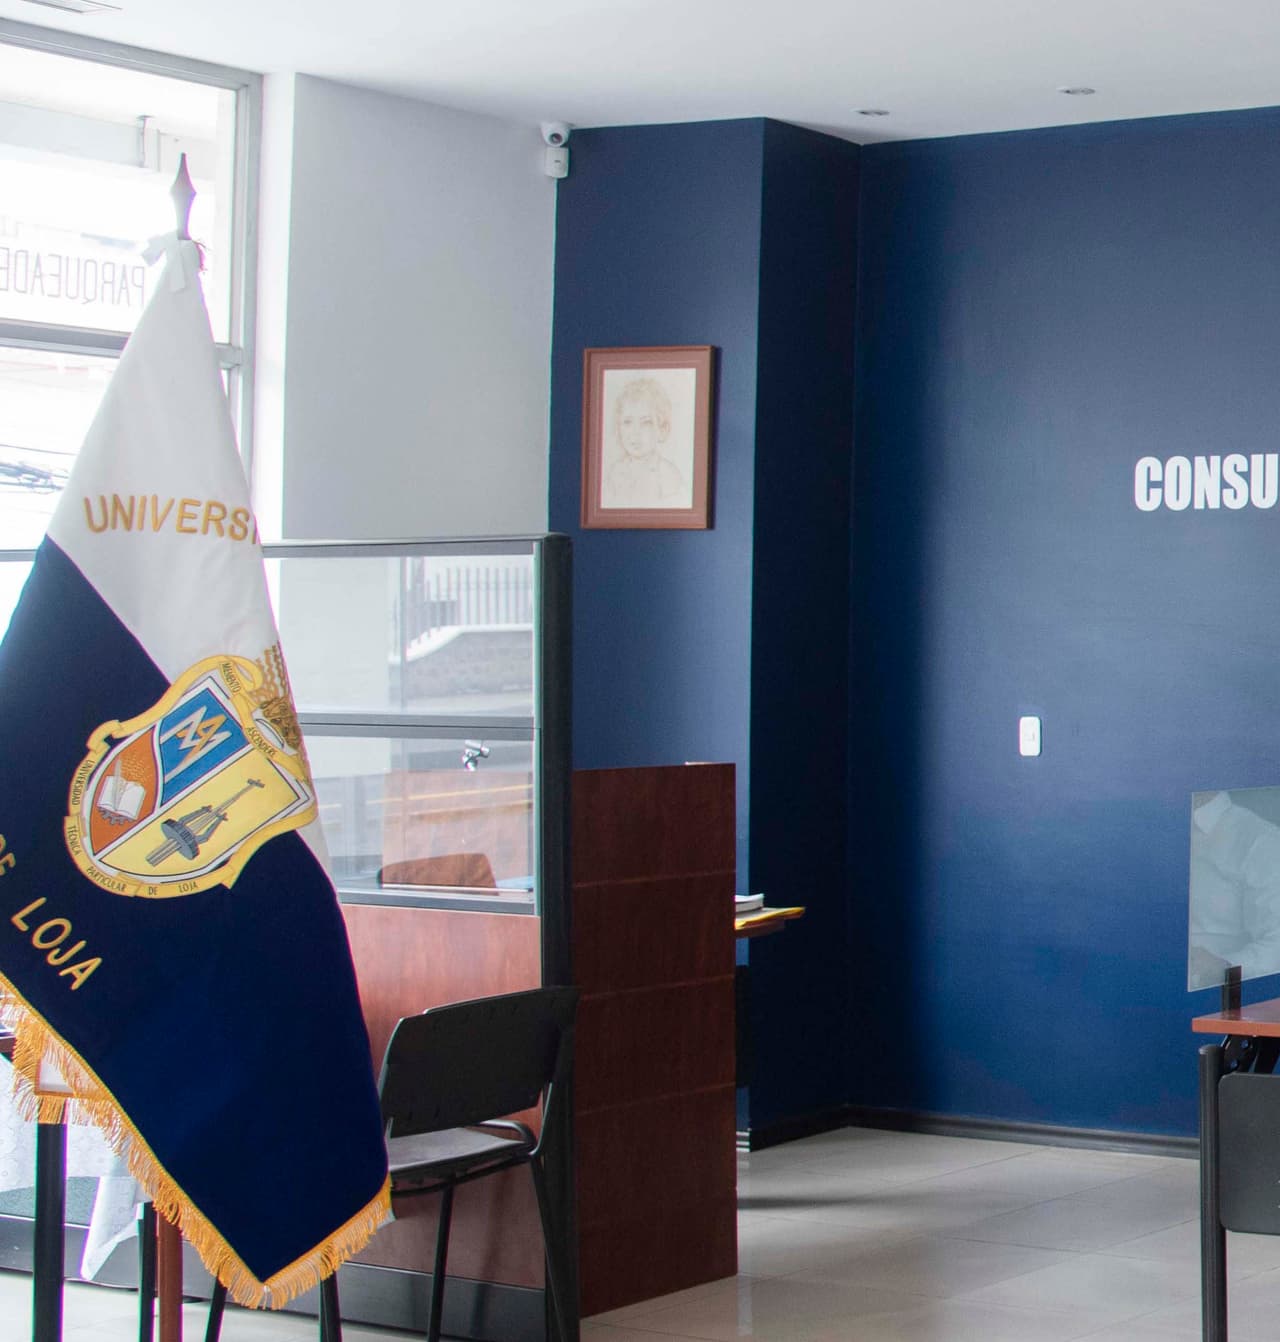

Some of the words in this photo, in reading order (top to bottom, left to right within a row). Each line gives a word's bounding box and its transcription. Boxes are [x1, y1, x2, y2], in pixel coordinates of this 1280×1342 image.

[71, 760, 96, 806] UNIVERSIDAD
[86, 865, 127, 892] PARTICULAR
[148, 886, 158, 896] DE
[178, 881, 200, 893] LOJA
[11, 896, 103, 990] LOJA
